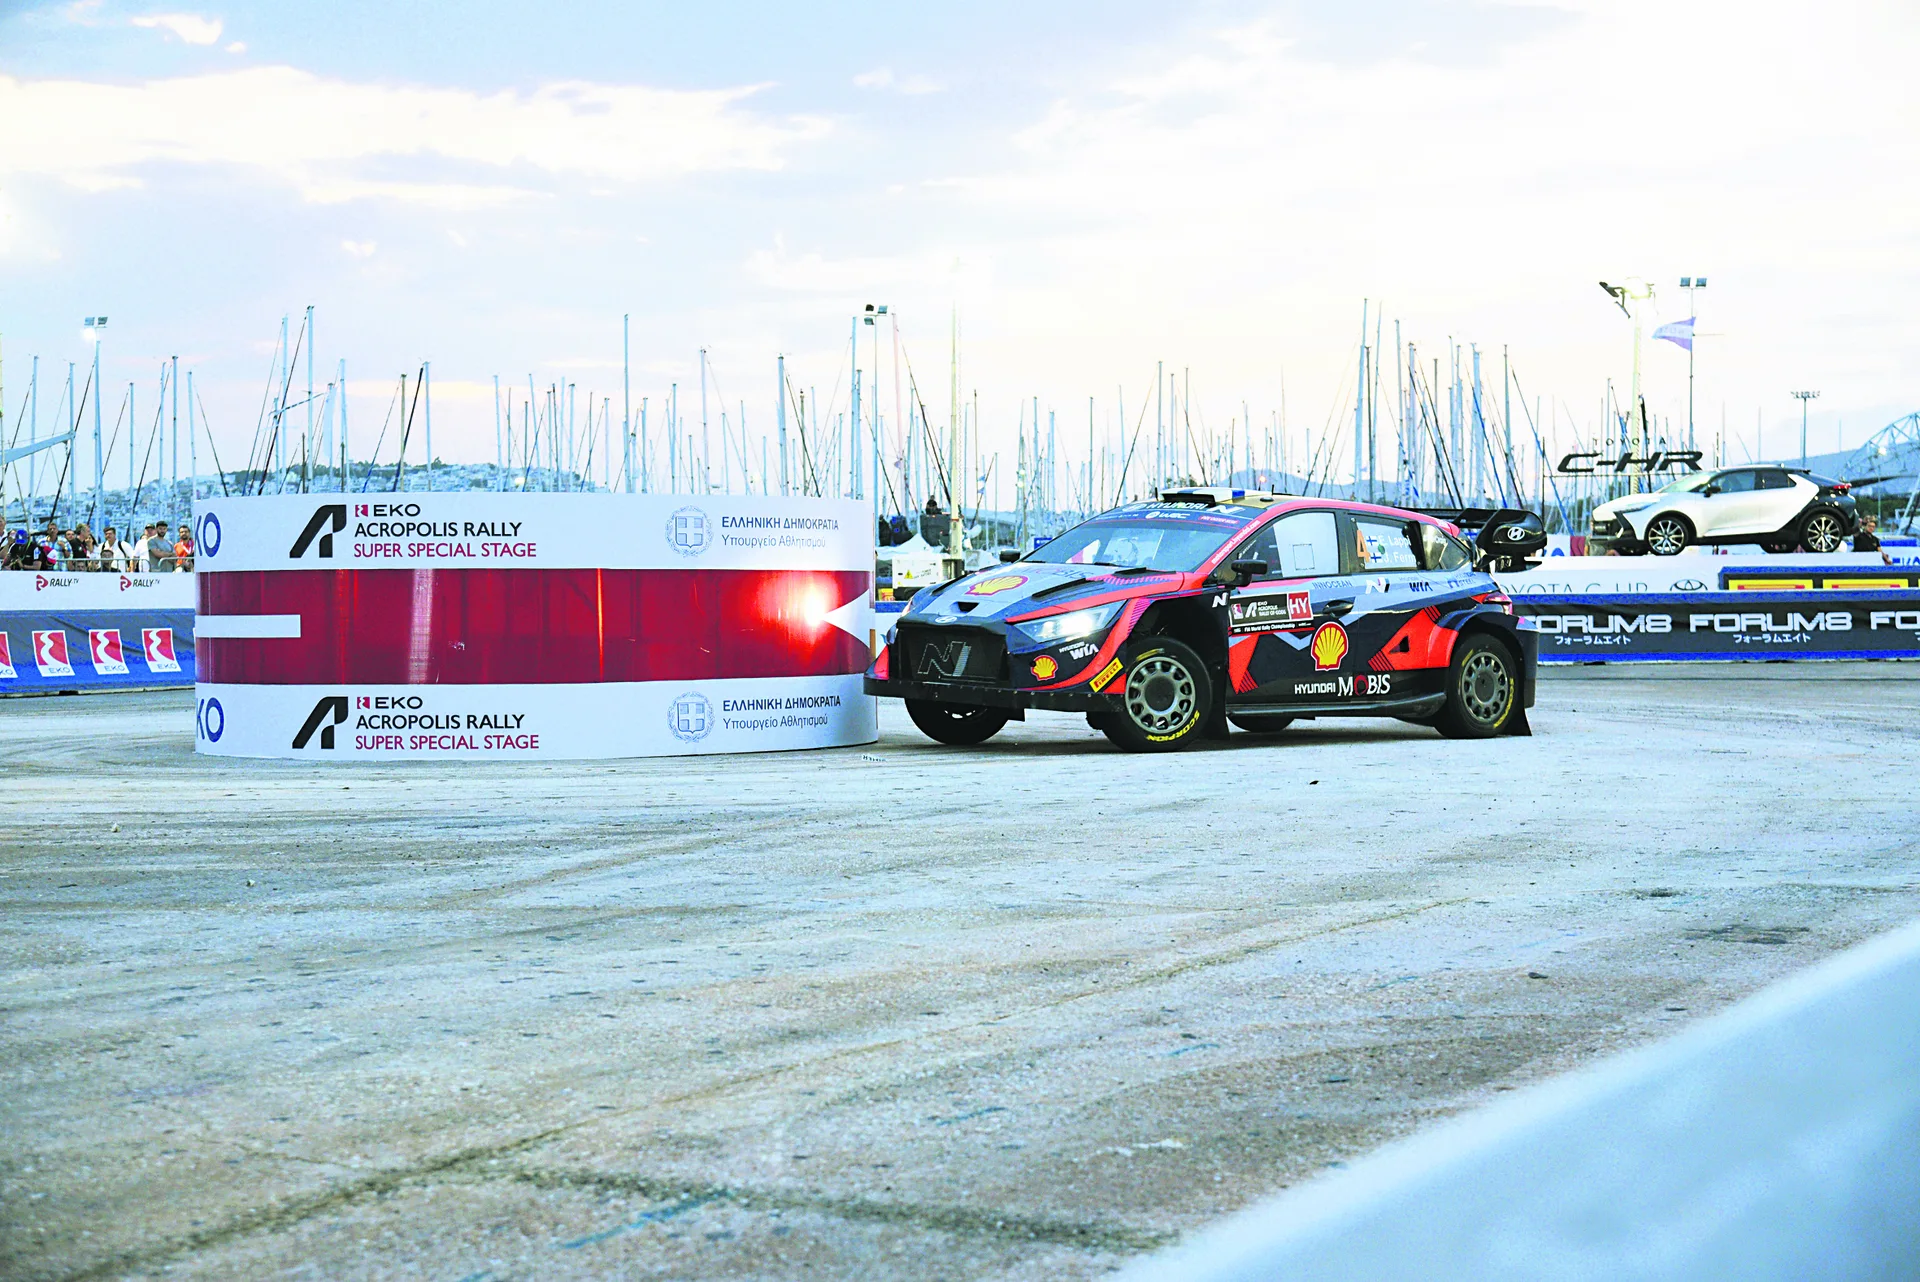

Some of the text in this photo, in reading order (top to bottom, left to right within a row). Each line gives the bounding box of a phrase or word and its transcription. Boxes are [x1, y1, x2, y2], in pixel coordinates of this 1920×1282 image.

[1558, 451, 1703, 472] C-HR
[373, 503, 421, 517] EKO
[354, 522, 522, 537] ACROPOLIS RALLY
[721, 516, 839, 530] ΕΛΛΗΝΙΚΗ ΔΗΜΟΚΡΑΤΙΑ
[721, 534, 826, 549] Υπουργείο Αθλητισμού
[1356, 530, 1371, 563] 4
[354, 543, 537, 557] SUPER SPECIAL STAGE
[1312, 578, 1352, 590] INNOCEAN
[1290, 597, 1308, 615] HY
[1690, 611, 1853, 632] FORUM8
[1294, 674, 1391, 697] HYUNDAI MOBIS
[375, 696, 423, 710] EKO
[723, 695, 841, 711] ΕΛΛΗΝΙΚΗ ΔΗΜΟΚΡΑΤΙΑ
[356, 714, 525, 730] ACROPOLIS RALLY
[723, 713, 828, 730] Υπουργείο Αθλητισμού
[355, 734, 540, 750] SUPER SPECIAL STAGE
